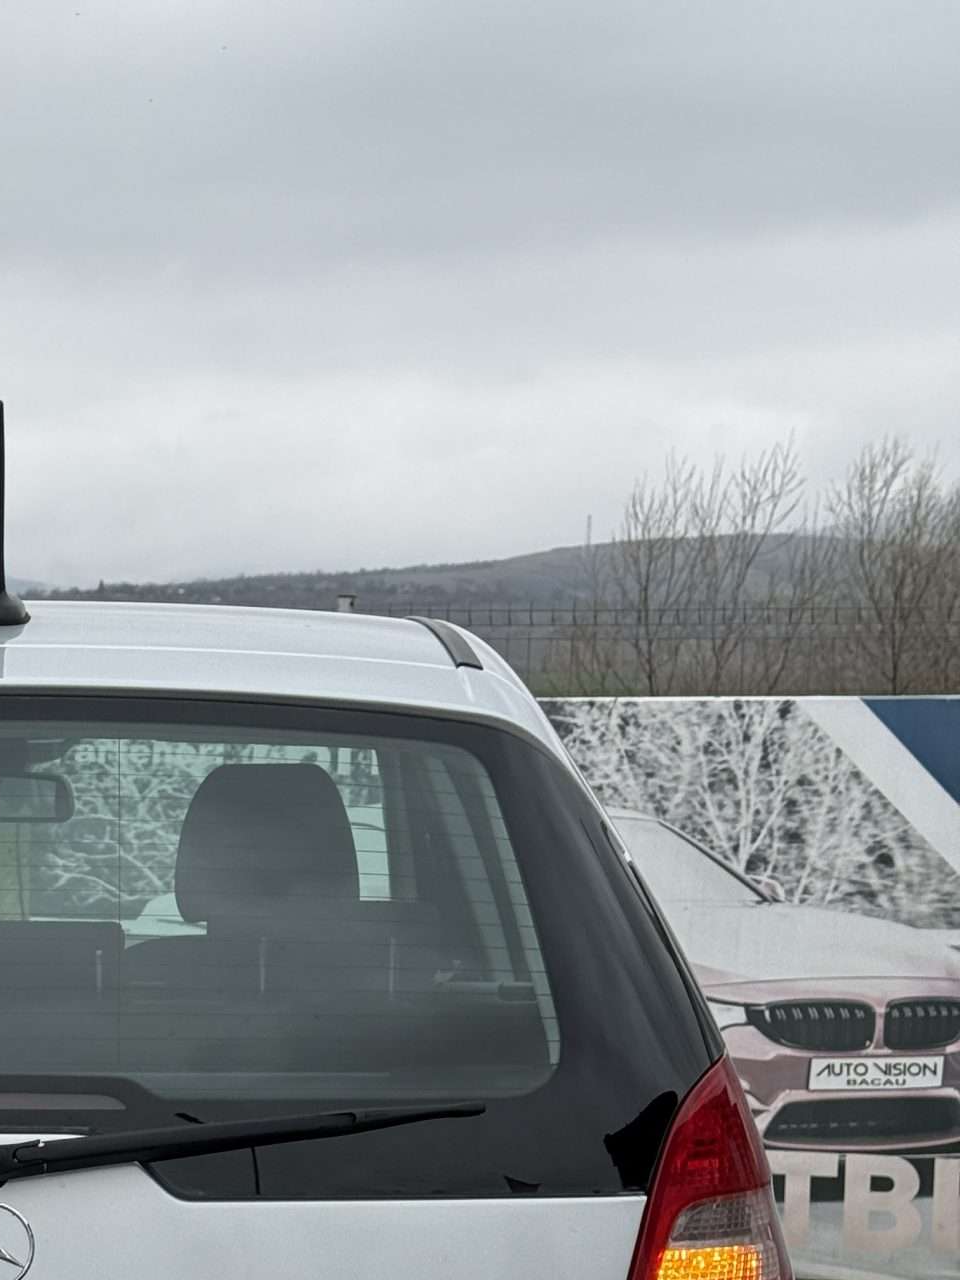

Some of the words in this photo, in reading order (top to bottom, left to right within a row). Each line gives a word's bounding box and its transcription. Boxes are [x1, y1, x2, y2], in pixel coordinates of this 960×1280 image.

[816, 1062, 869, 1077] AUTO
[873, 1062, 938, 1077] VISION
[846, 1078, 907, 1086] BACAU
